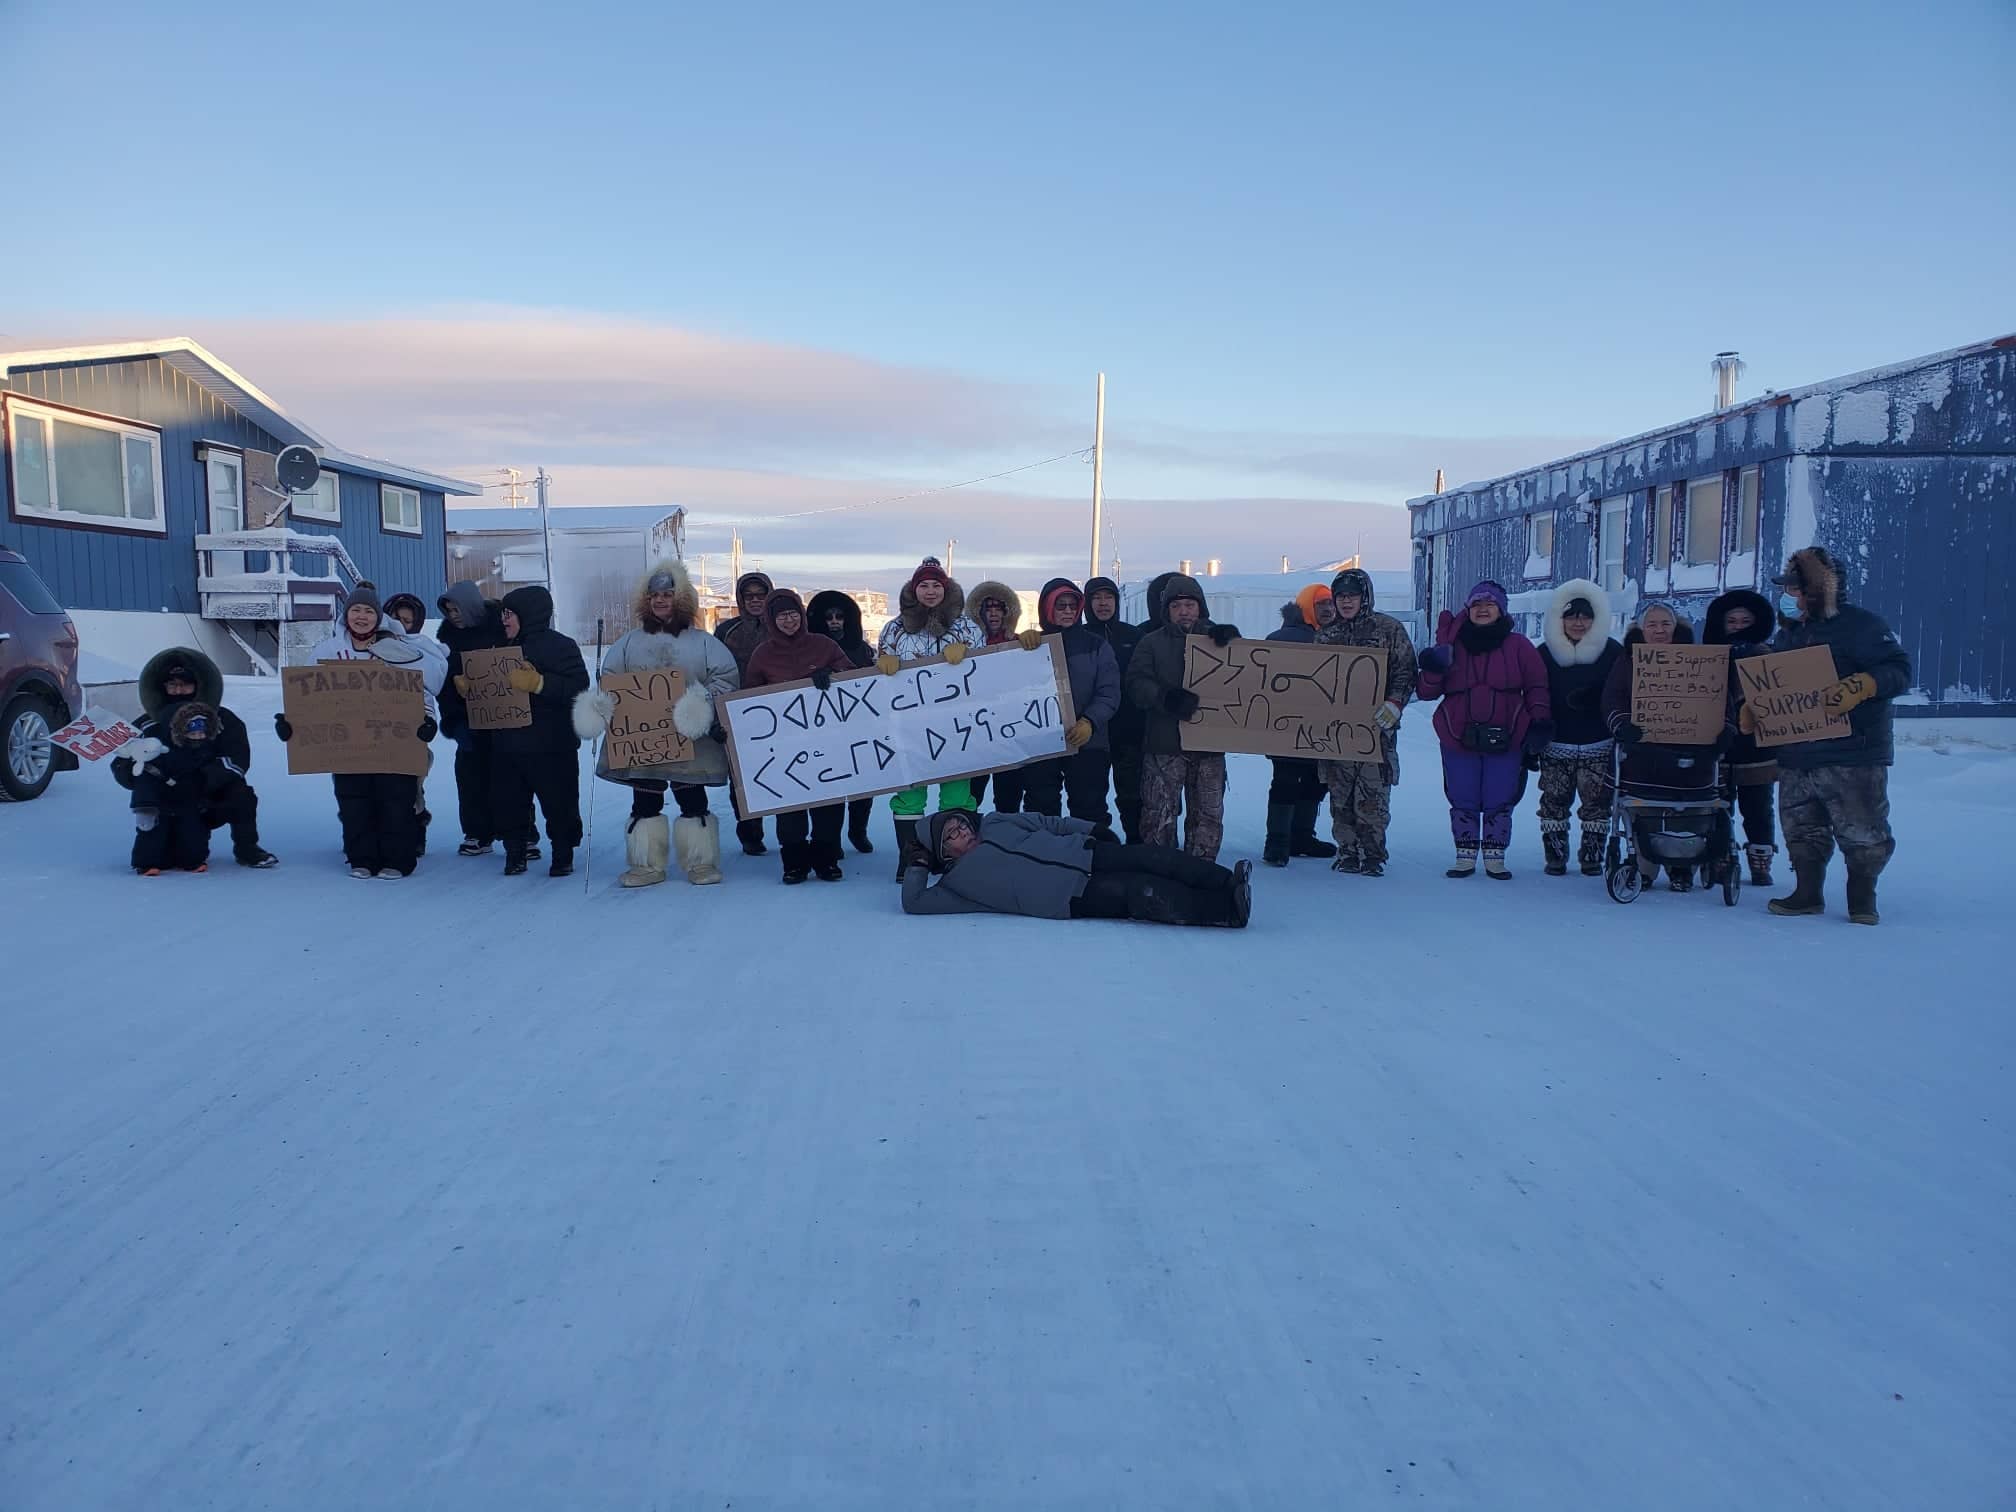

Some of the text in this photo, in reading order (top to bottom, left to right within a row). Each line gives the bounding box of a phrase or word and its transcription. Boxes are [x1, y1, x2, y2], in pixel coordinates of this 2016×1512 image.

[1638, 648, 1670, 665] WE
[1739, 658, 1789, 692] WE
[1637, 700, 1682, 711] NO TO
[50, 715, 95, 743] MY
